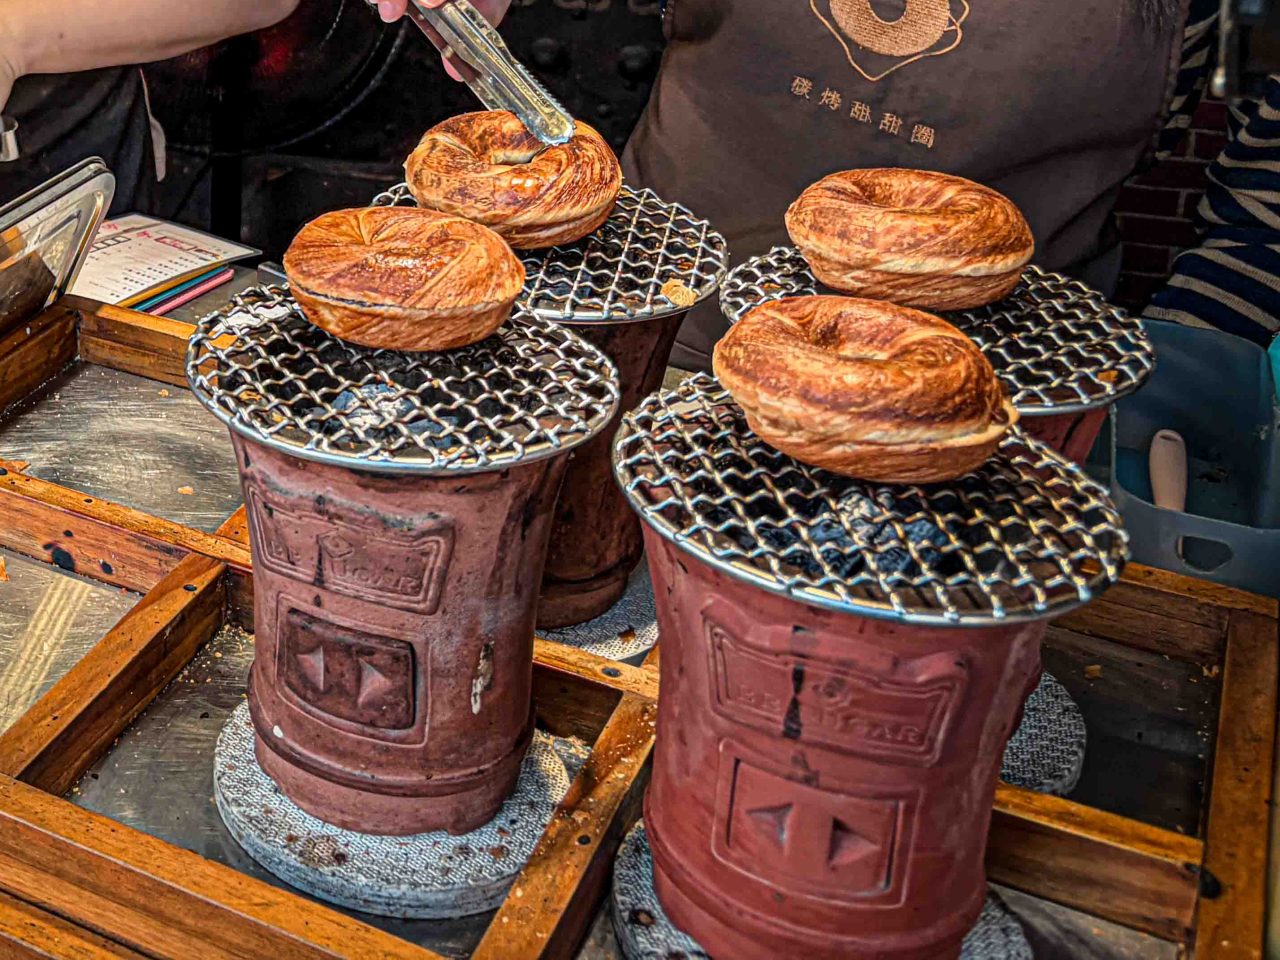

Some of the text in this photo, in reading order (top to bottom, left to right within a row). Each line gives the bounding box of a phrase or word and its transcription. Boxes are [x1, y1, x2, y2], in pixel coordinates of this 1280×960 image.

[790, 74, 936, 149] 碳烤甜甜圈
